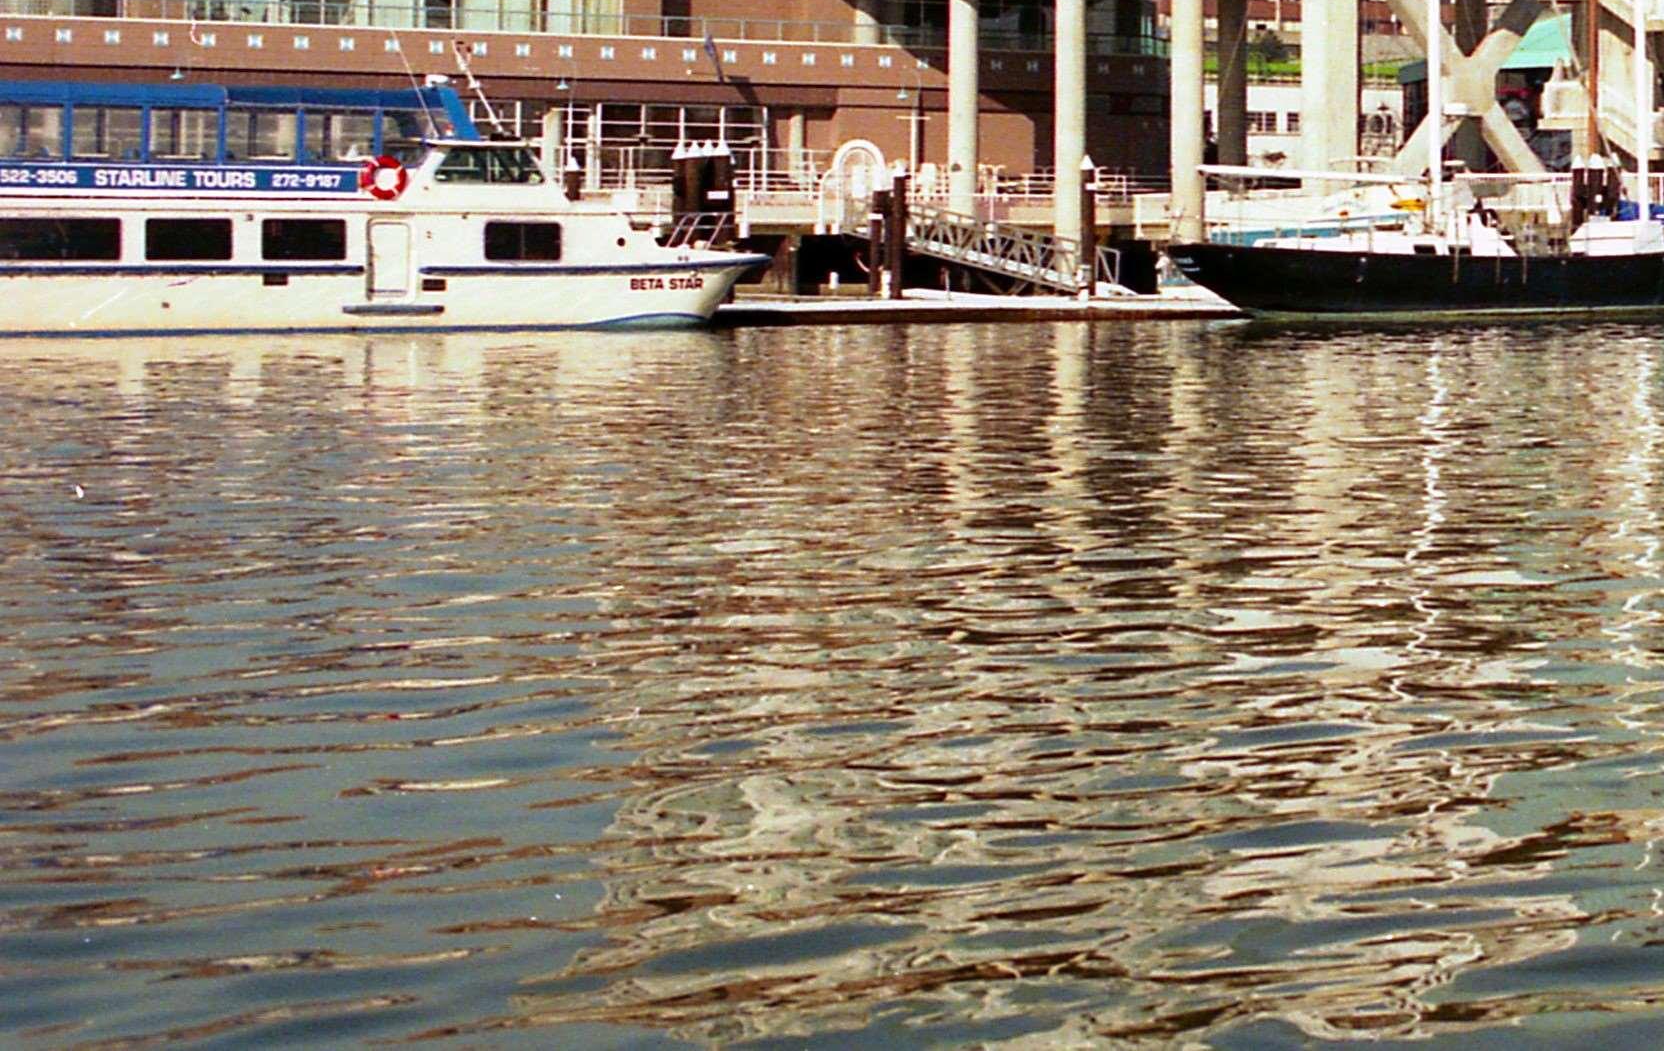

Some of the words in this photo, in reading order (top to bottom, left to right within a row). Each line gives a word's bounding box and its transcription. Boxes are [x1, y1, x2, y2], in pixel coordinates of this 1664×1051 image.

[0, 169, 78, 184] 522-3506
[94, 170, 188, 187] STARLINE
[193, 170, 257, 188] TOURS
[271, 173, 342, 188] 272-9187
[630, 278, 664, 290] BETA
[669, 278, 704, 290] STAR
